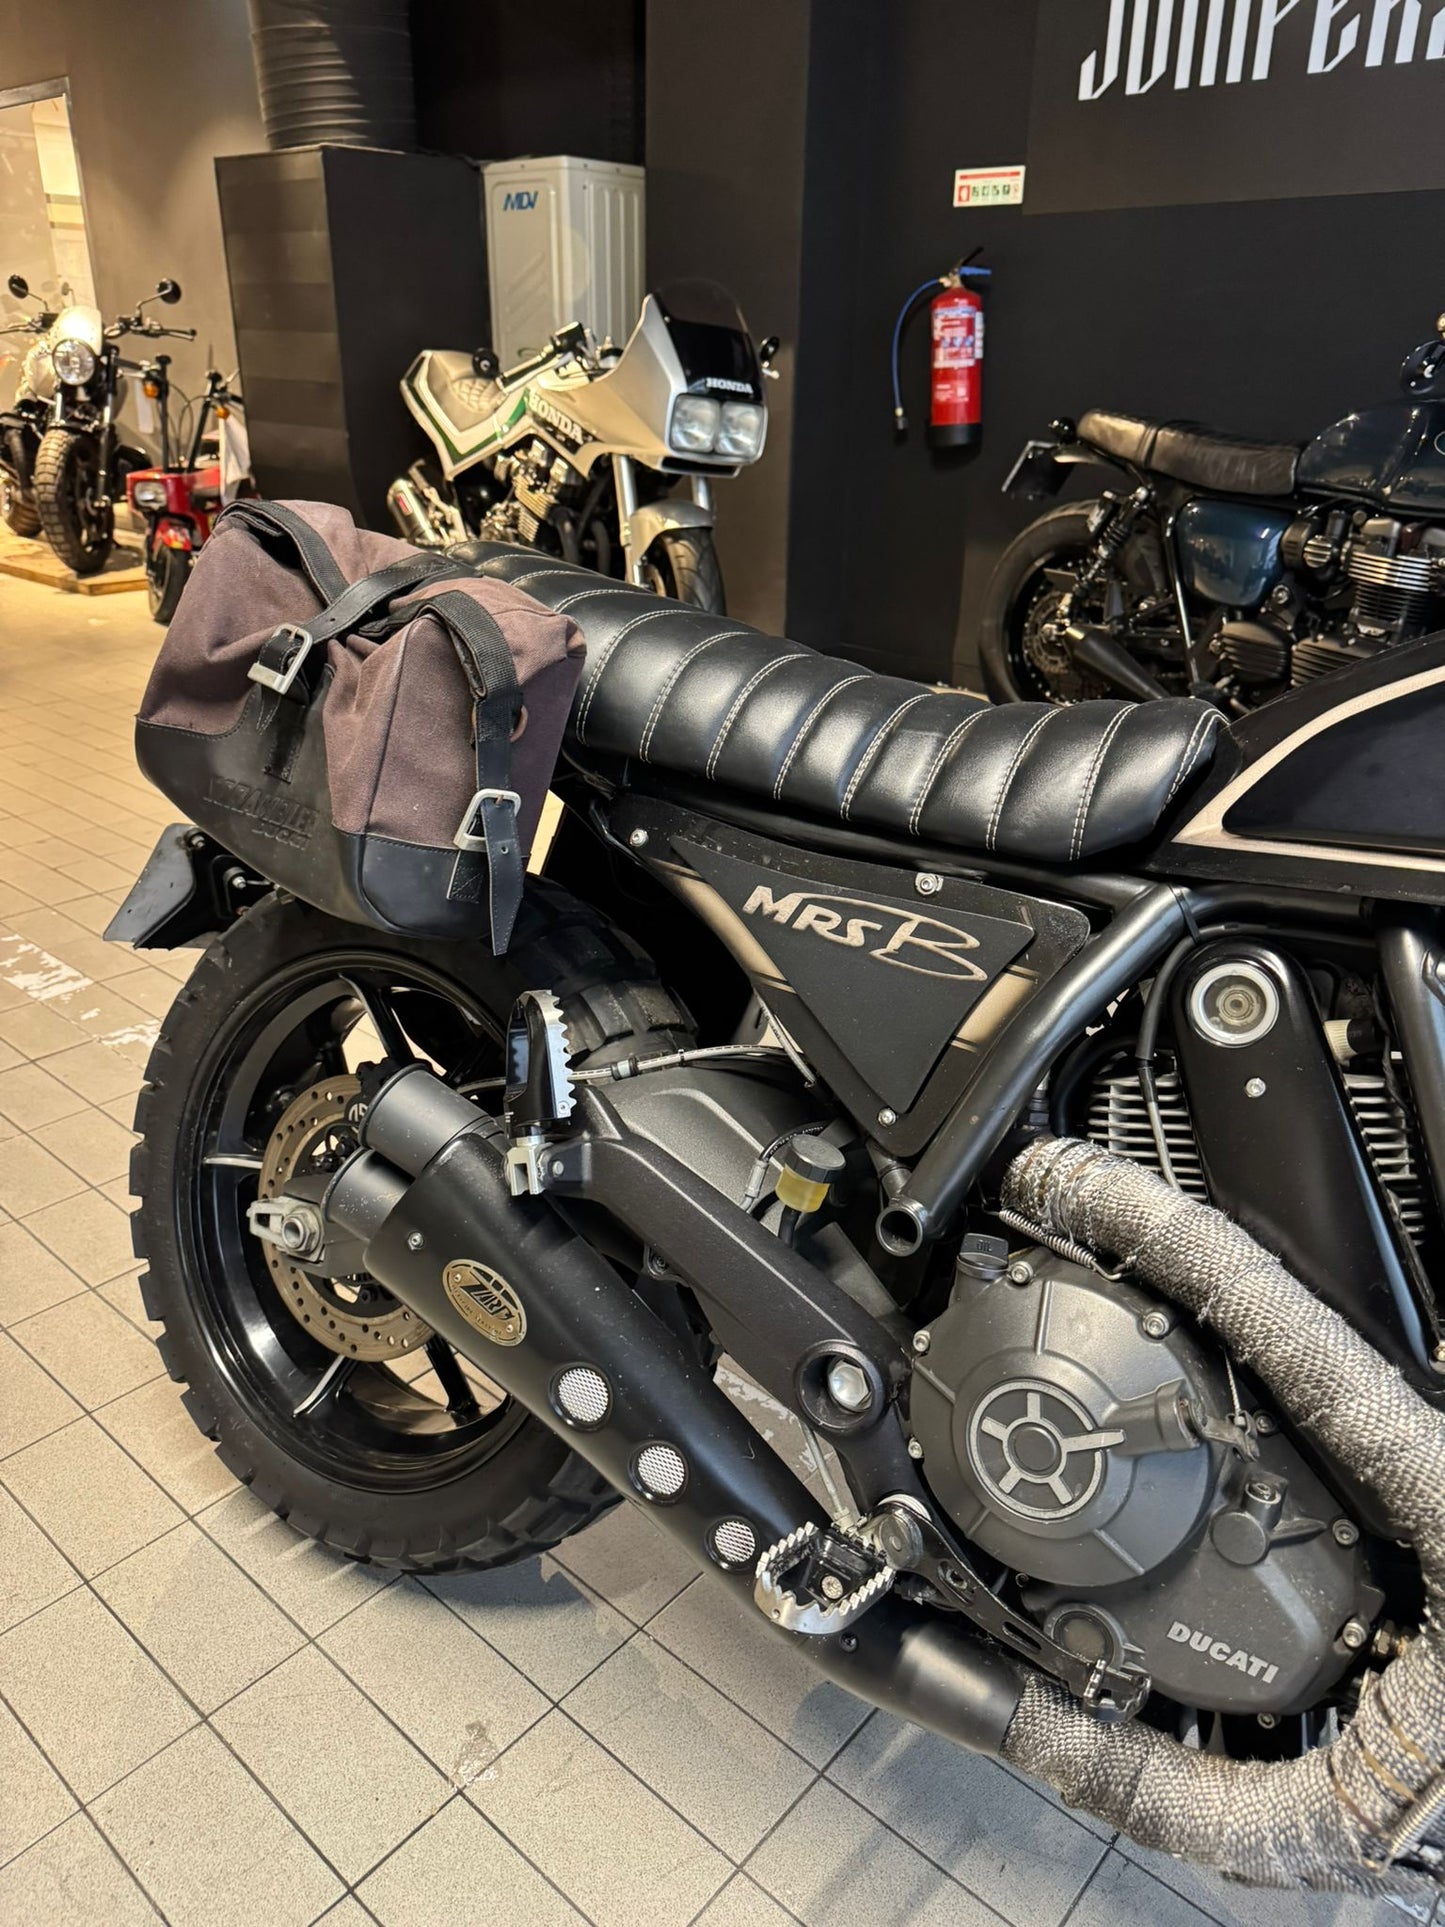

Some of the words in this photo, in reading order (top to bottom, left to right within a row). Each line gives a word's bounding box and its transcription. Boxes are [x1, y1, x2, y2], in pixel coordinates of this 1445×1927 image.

[705, 377, 754, 394] HONDA
[529, 391, 584, 445] HONDA
[1167, 1620, 1280, 1684] DUCATI
